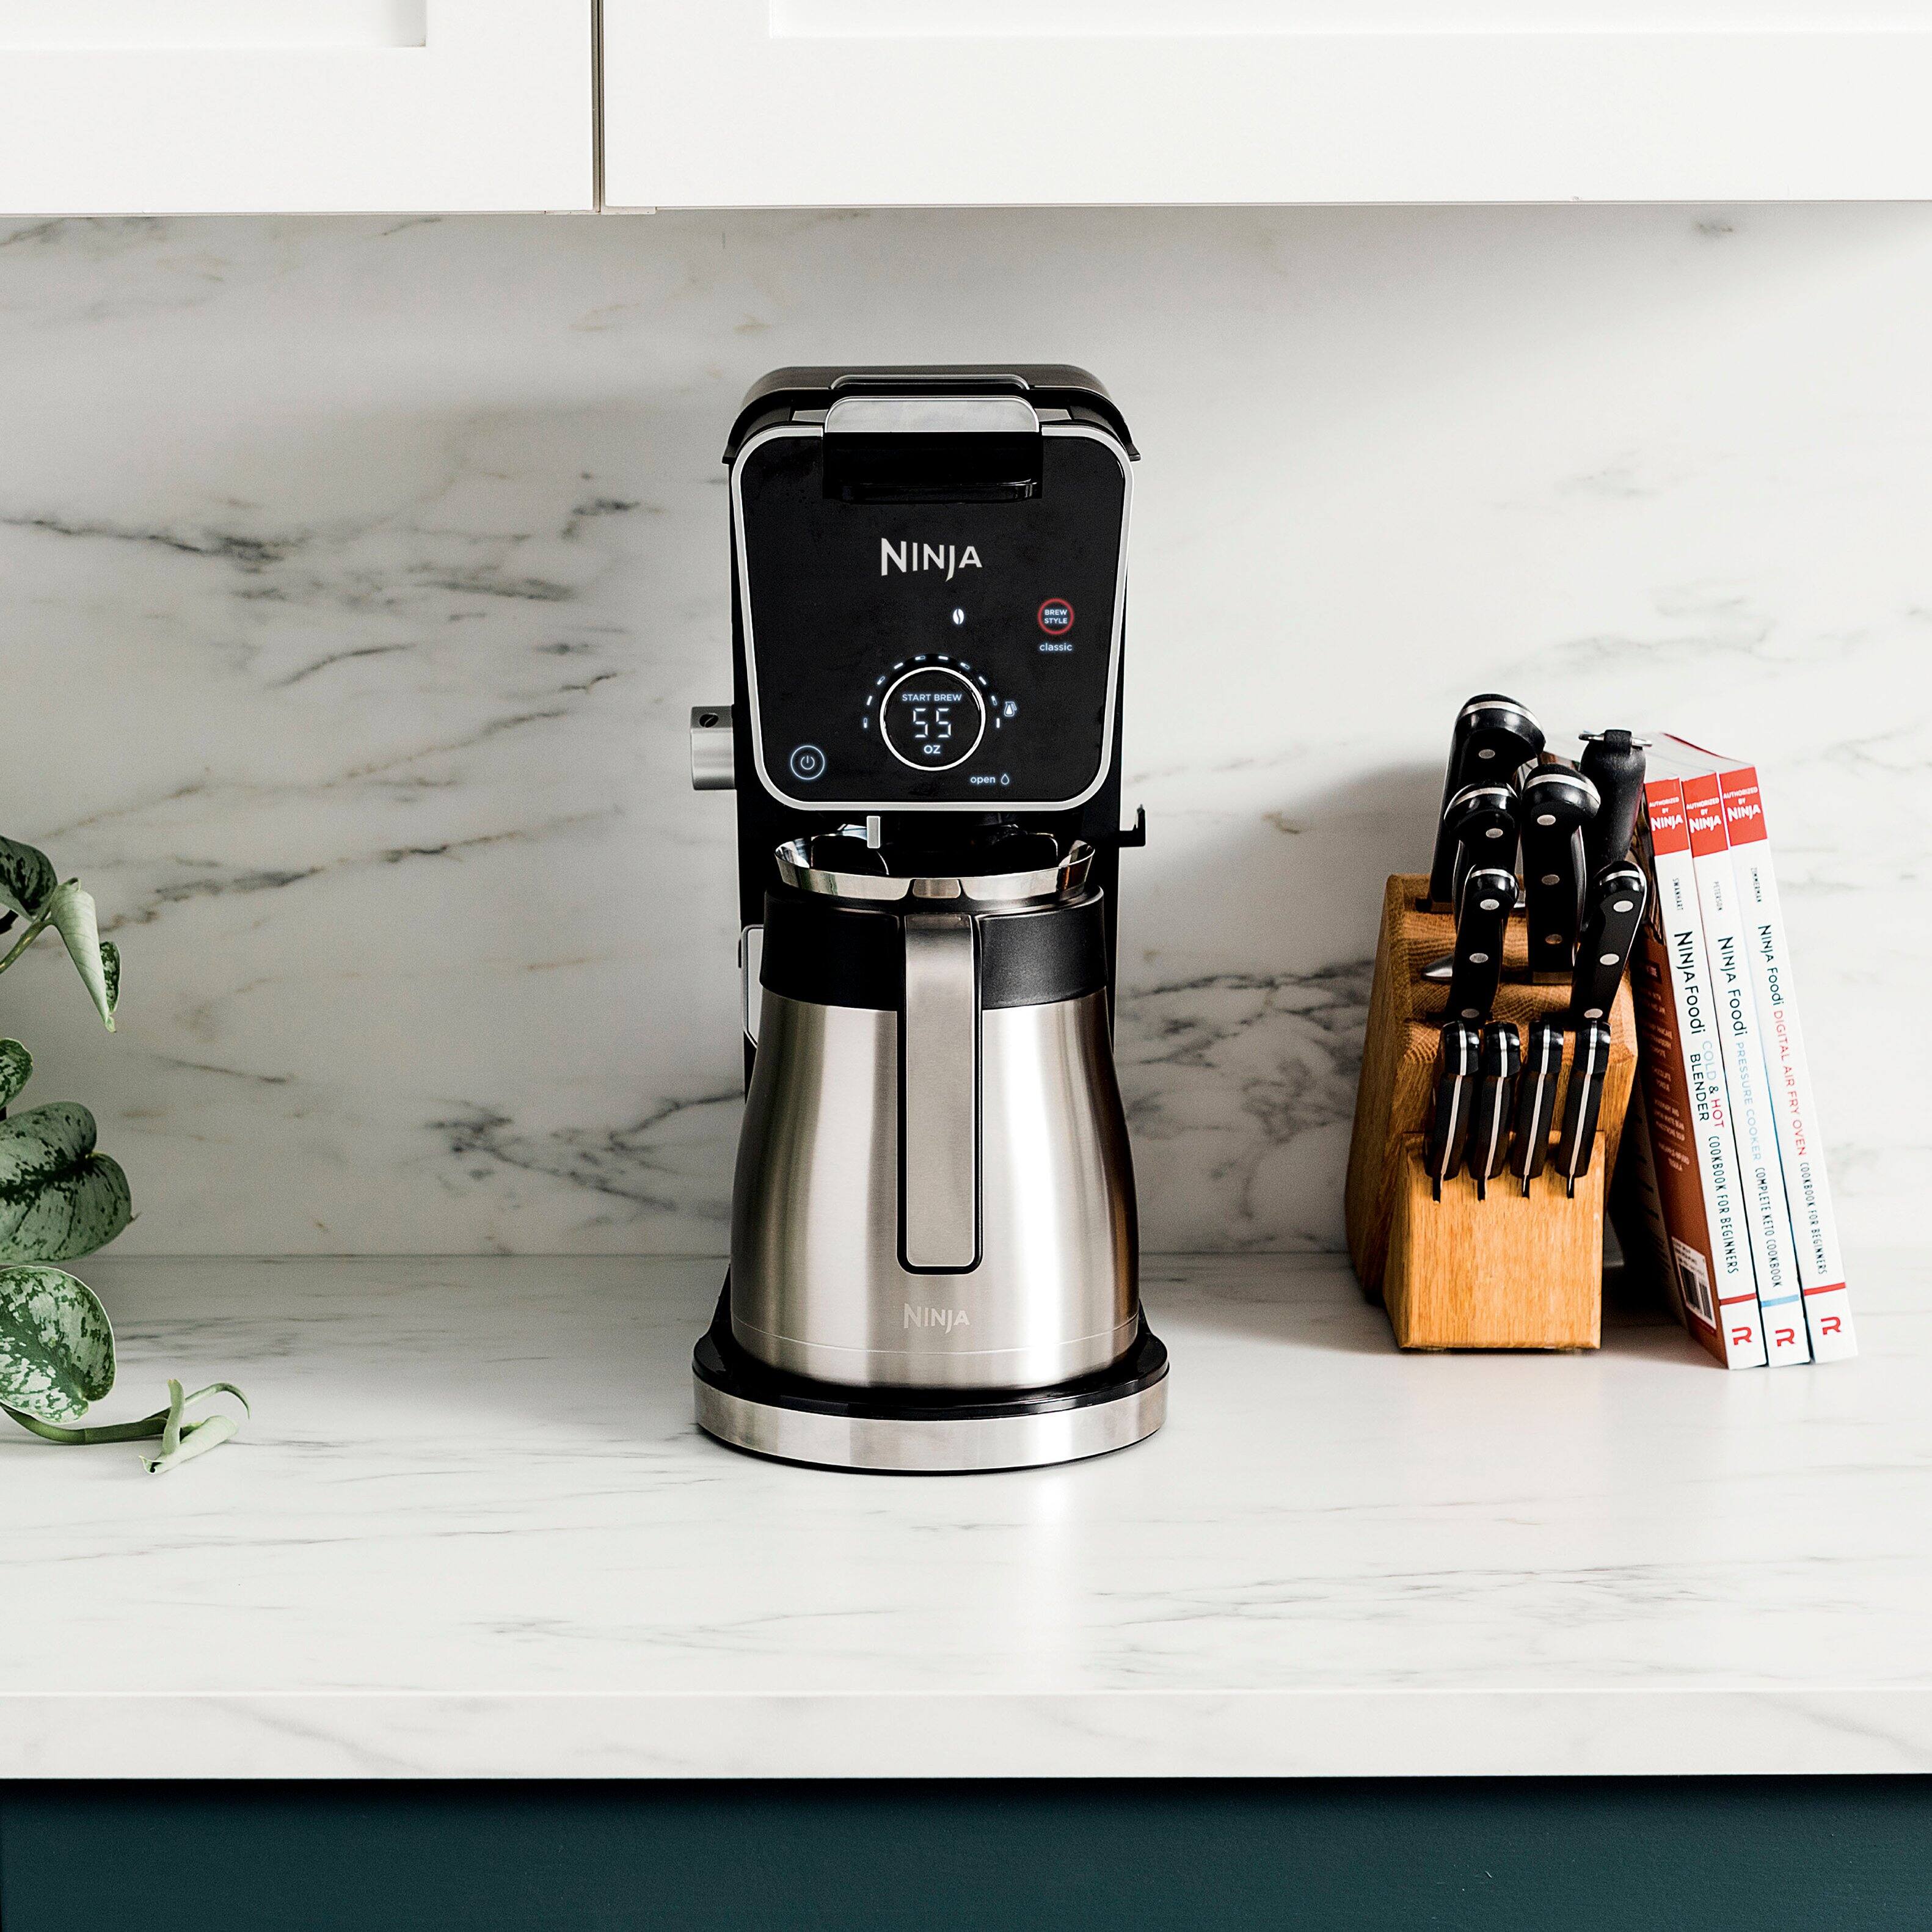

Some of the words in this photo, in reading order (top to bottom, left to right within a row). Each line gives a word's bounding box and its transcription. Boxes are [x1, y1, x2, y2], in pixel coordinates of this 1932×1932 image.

[881, 538, 982, 581] NINJA
[1040, 643, 1072, 651] classic
[913, 708, 951, 738] 55
[924, 745, 940, 754] OZ
[1649, 797, 1679, 807] AUTHORIZED
[1686, 797, 1719, 809] AUTHORIZED
[1723, 787, 1758, 798] AUTHORIZED
[1651, 815, 1683, 831] NINJA
[1690, 815, 1721, 833] NINJA
[1727, 804, 1761, 822] NINJA
[1718, 936, 1736, 983] NINJA
[1758, 925, 1774, 963] NINJA
[1674, 931, 1695, 983] NINJA
[1685, 985, 1705, 1034] Foodi
[1767, 968, 1784, 1005] Foodi
[1728, 989, 1748, 1036] Foodi
[1774, 1010, 1789, 1061] DIGITAL
[1690, 1054, 1709, 1121] BLENDER
[1702, 1041, 1716, 1081] COLD
[1711, 1099, 1724, 1128] HOT
[1736, 1042, 1752, 1104] PRESSURE
[1784, 1066, 1795, 1086] AIR
[1788, 1091, 1799, 1114] FRY
[1746, 1109, 1761, 1161] COOKER
[1793, 1120, 1806, 1156] OVEN
[1708, 1136, 1726, 1191] COOKBOOK
[1755, 1168, 1771, 1211] COMPLETE
[1800, 1162, 1815, 1206] COOKBOOK
[1717, 1195, 1730, 1214] FOR
[1809, 1210, 1818, 1225] FOR
[1763, 1214, 1774, 1236] KETO
[1720, 1217, 1738, 1274] BEGINNERS
[1766, 1239, 1782, 1287] COOKBOOK
[1812, 1229, 1827, 1274] BEGINNERS
[904, 1303, 971, 1334] NINJA
